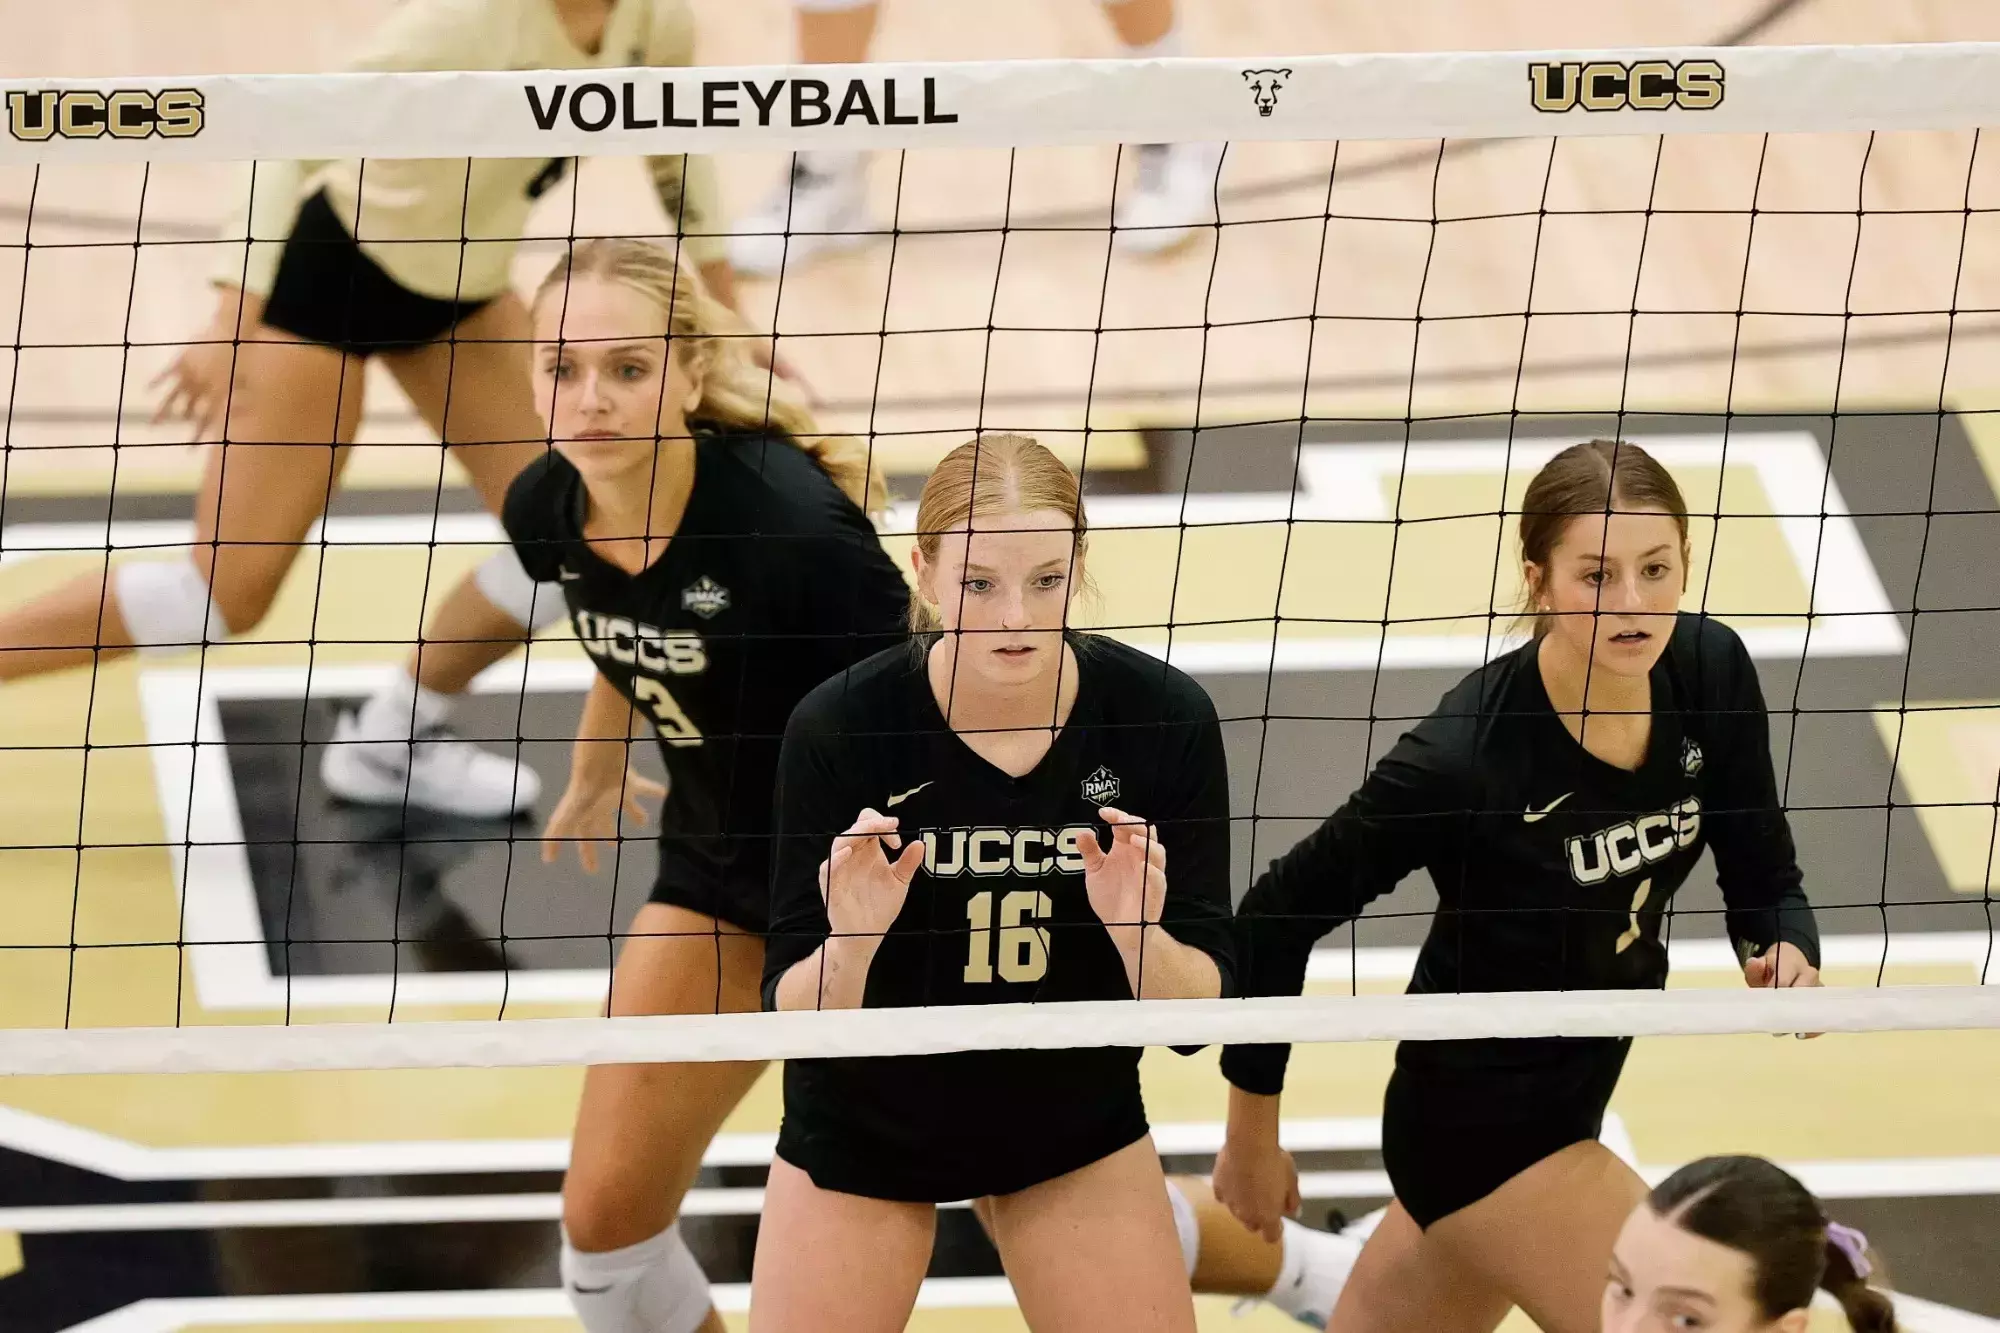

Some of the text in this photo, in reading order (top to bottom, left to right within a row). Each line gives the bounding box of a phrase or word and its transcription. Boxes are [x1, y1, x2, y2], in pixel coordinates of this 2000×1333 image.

[6, 89, 205, 141] UCCS
[524, 77, 959, 132] VOLLEYBALL
[1528, 60, 1725, 112] UCCS
[577, 610, 710, 675] UCCS
[632, 675, 704, 748] 3
[920, 823, 1099, 878] UCCS
[1565, 796, 1701, 886] UCCS
[963, 890, 1053, 983] 16
